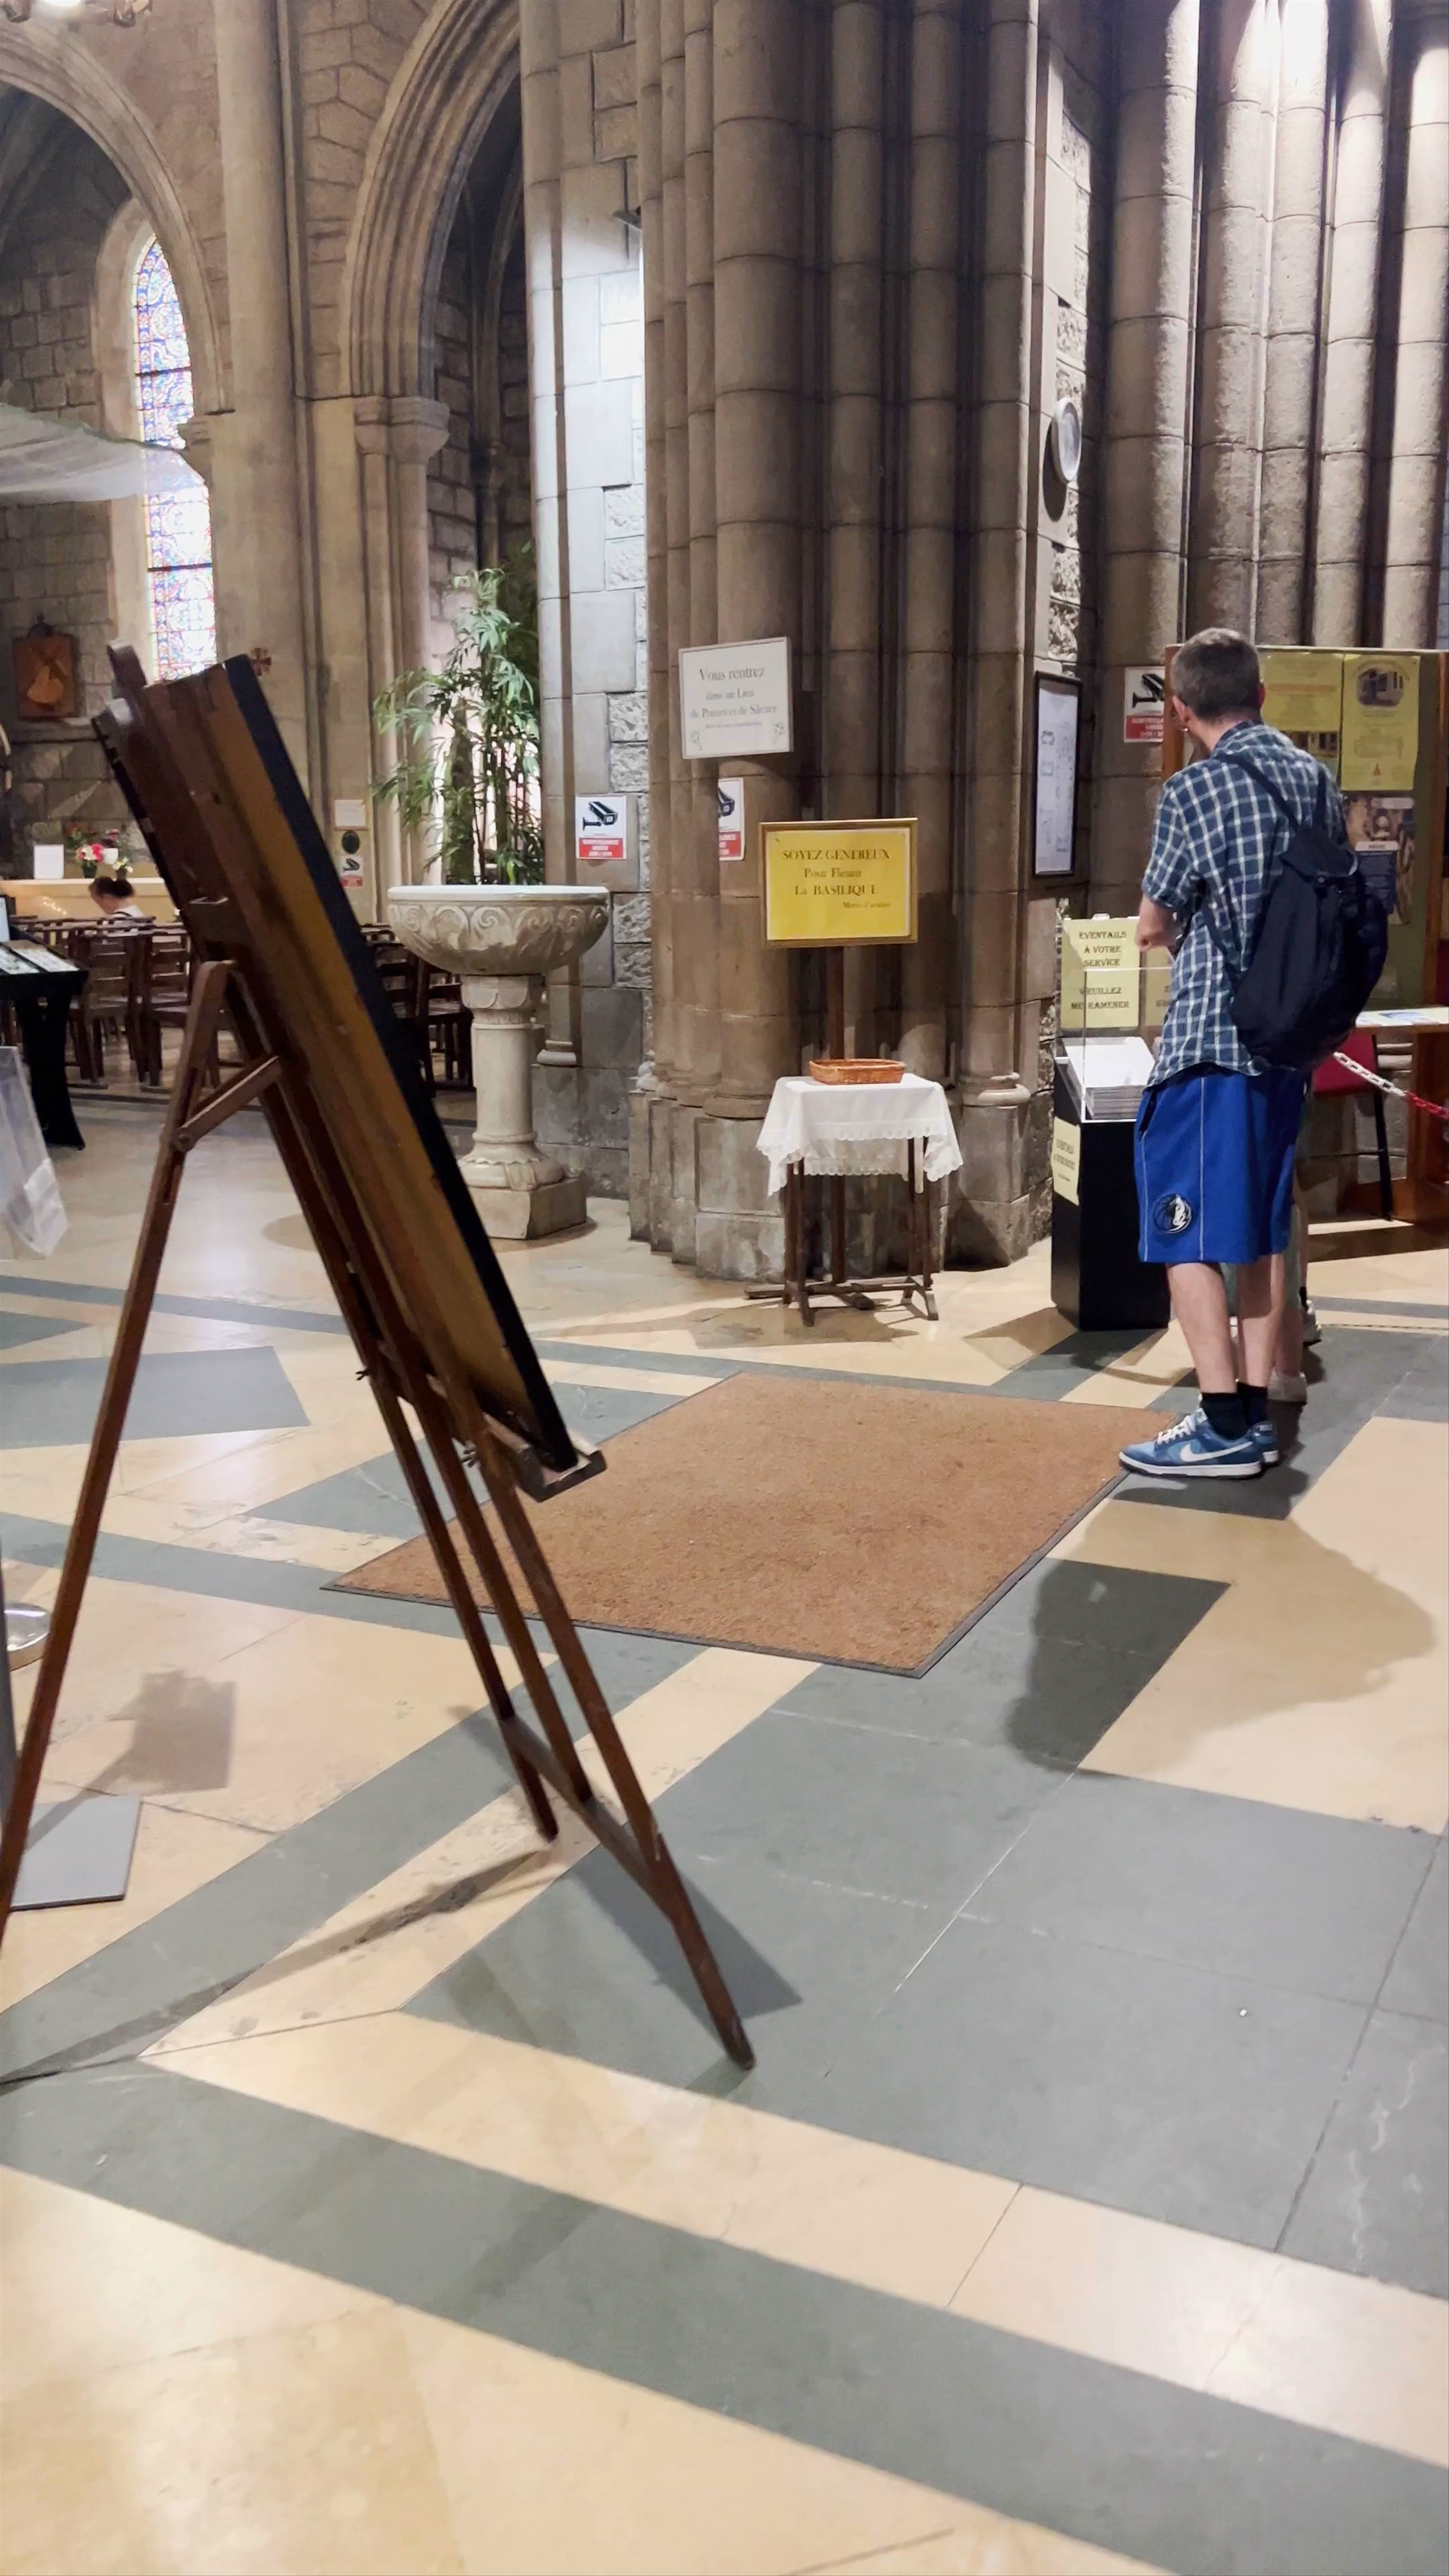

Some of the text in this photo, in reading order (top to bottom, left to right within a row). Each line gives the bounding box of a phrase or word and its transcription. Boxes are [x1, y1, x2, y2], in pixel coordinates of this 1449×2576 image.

[700, 667, 765, 680] Vous rentrez
[750, 704, 777, 714] Silence
[782, 849, 823, 860] SOYEZ
[804, 868, 828, 878] Pour
[795, 884, 877, 896] La BASILIQUE
[1079, 931, 1127, 940] EVENTAILS
[1093, 945, 1122, 953] VOTRE
[1084, 958, 1120, 967] SERVICE
